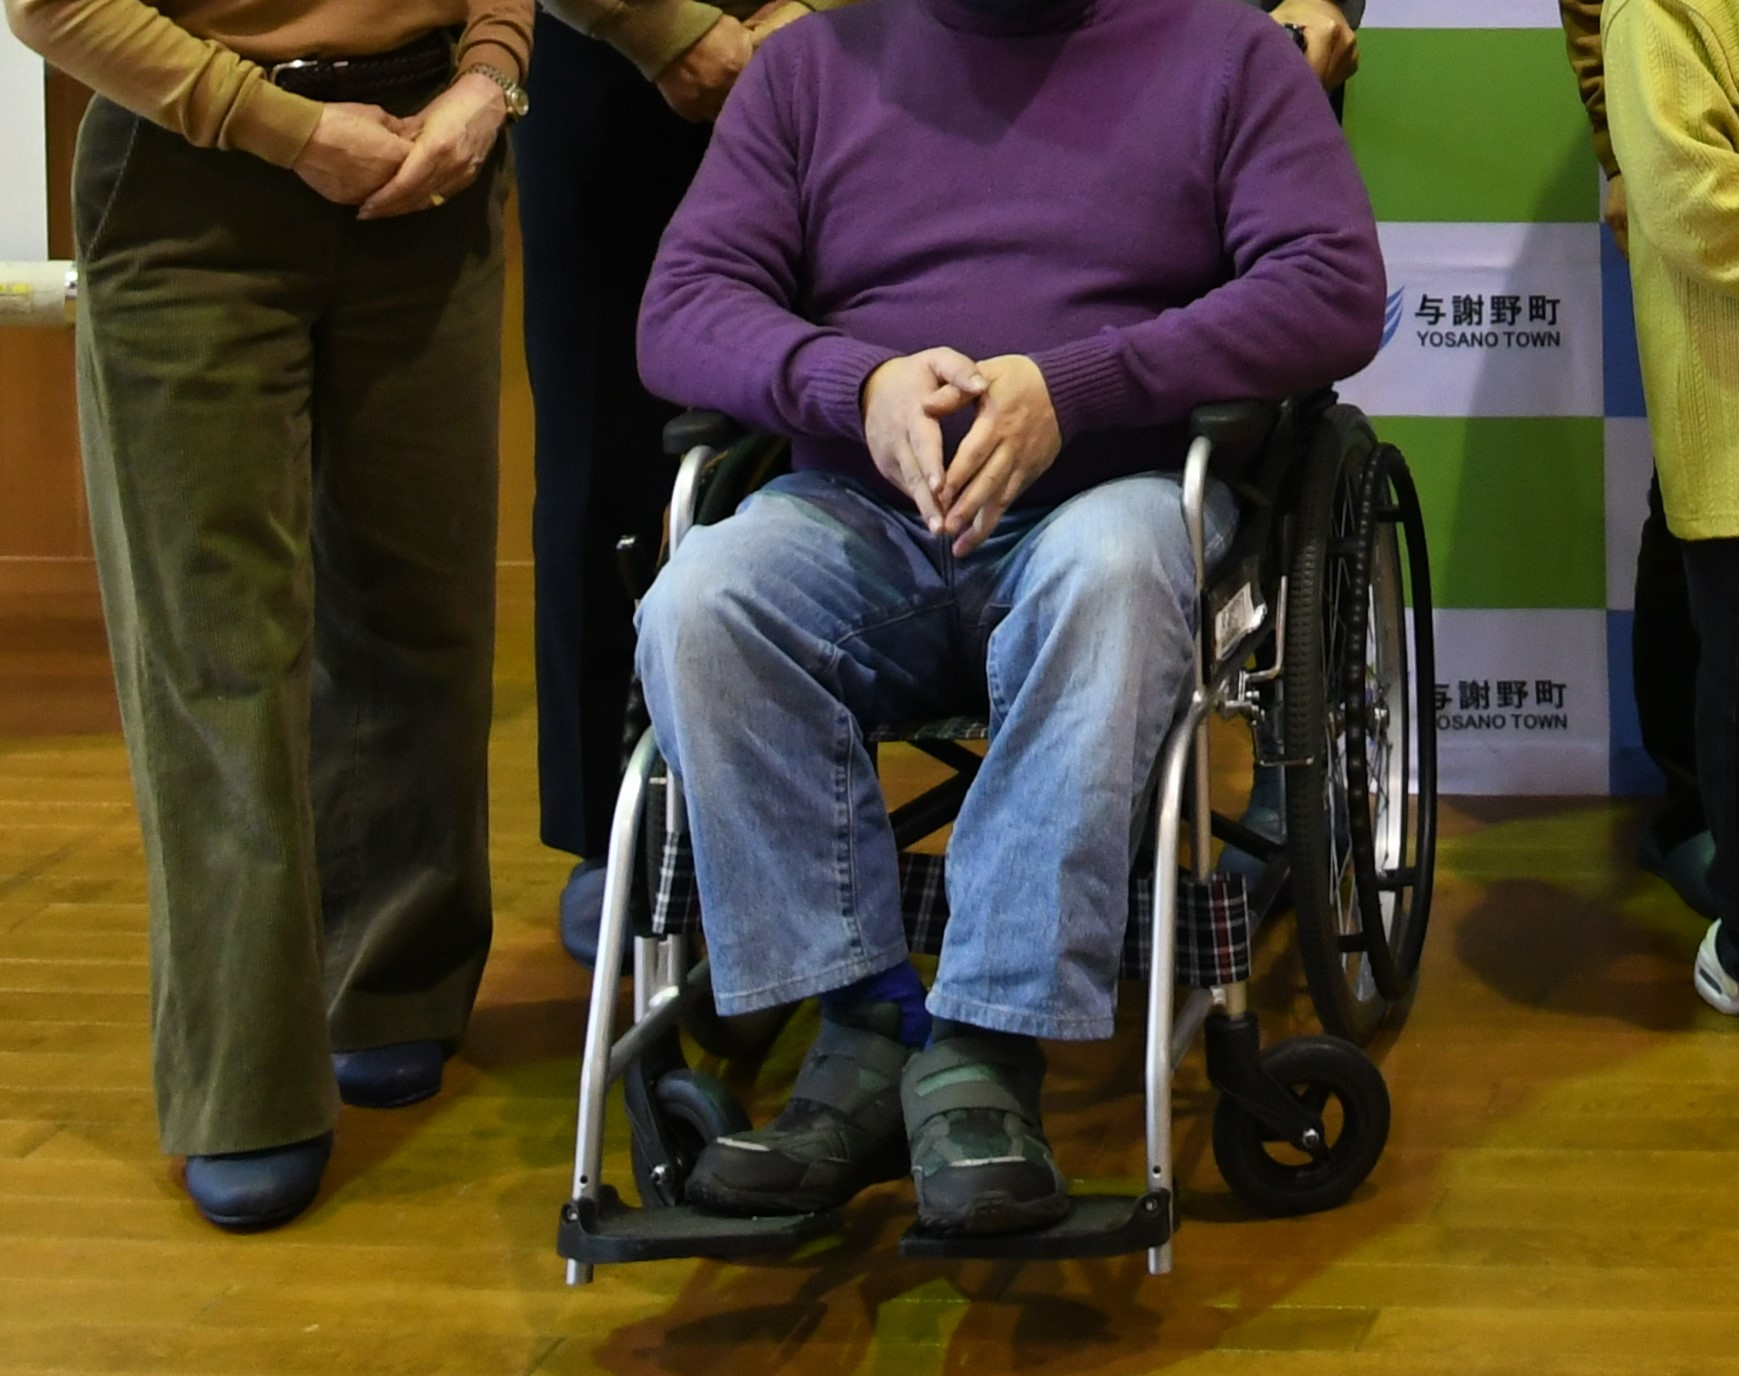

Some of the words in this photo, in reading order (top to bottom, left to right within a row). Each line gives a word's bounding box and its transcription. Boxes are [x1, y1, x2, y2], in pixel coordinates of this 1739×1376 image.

[1414, 293, 1561, 327] 与謝野町
[1416, 330, 1499, 348] YOSANO
[1502, 331, 1561, 349] TOWN
[1510, 713, 1568, 731] TOWN
